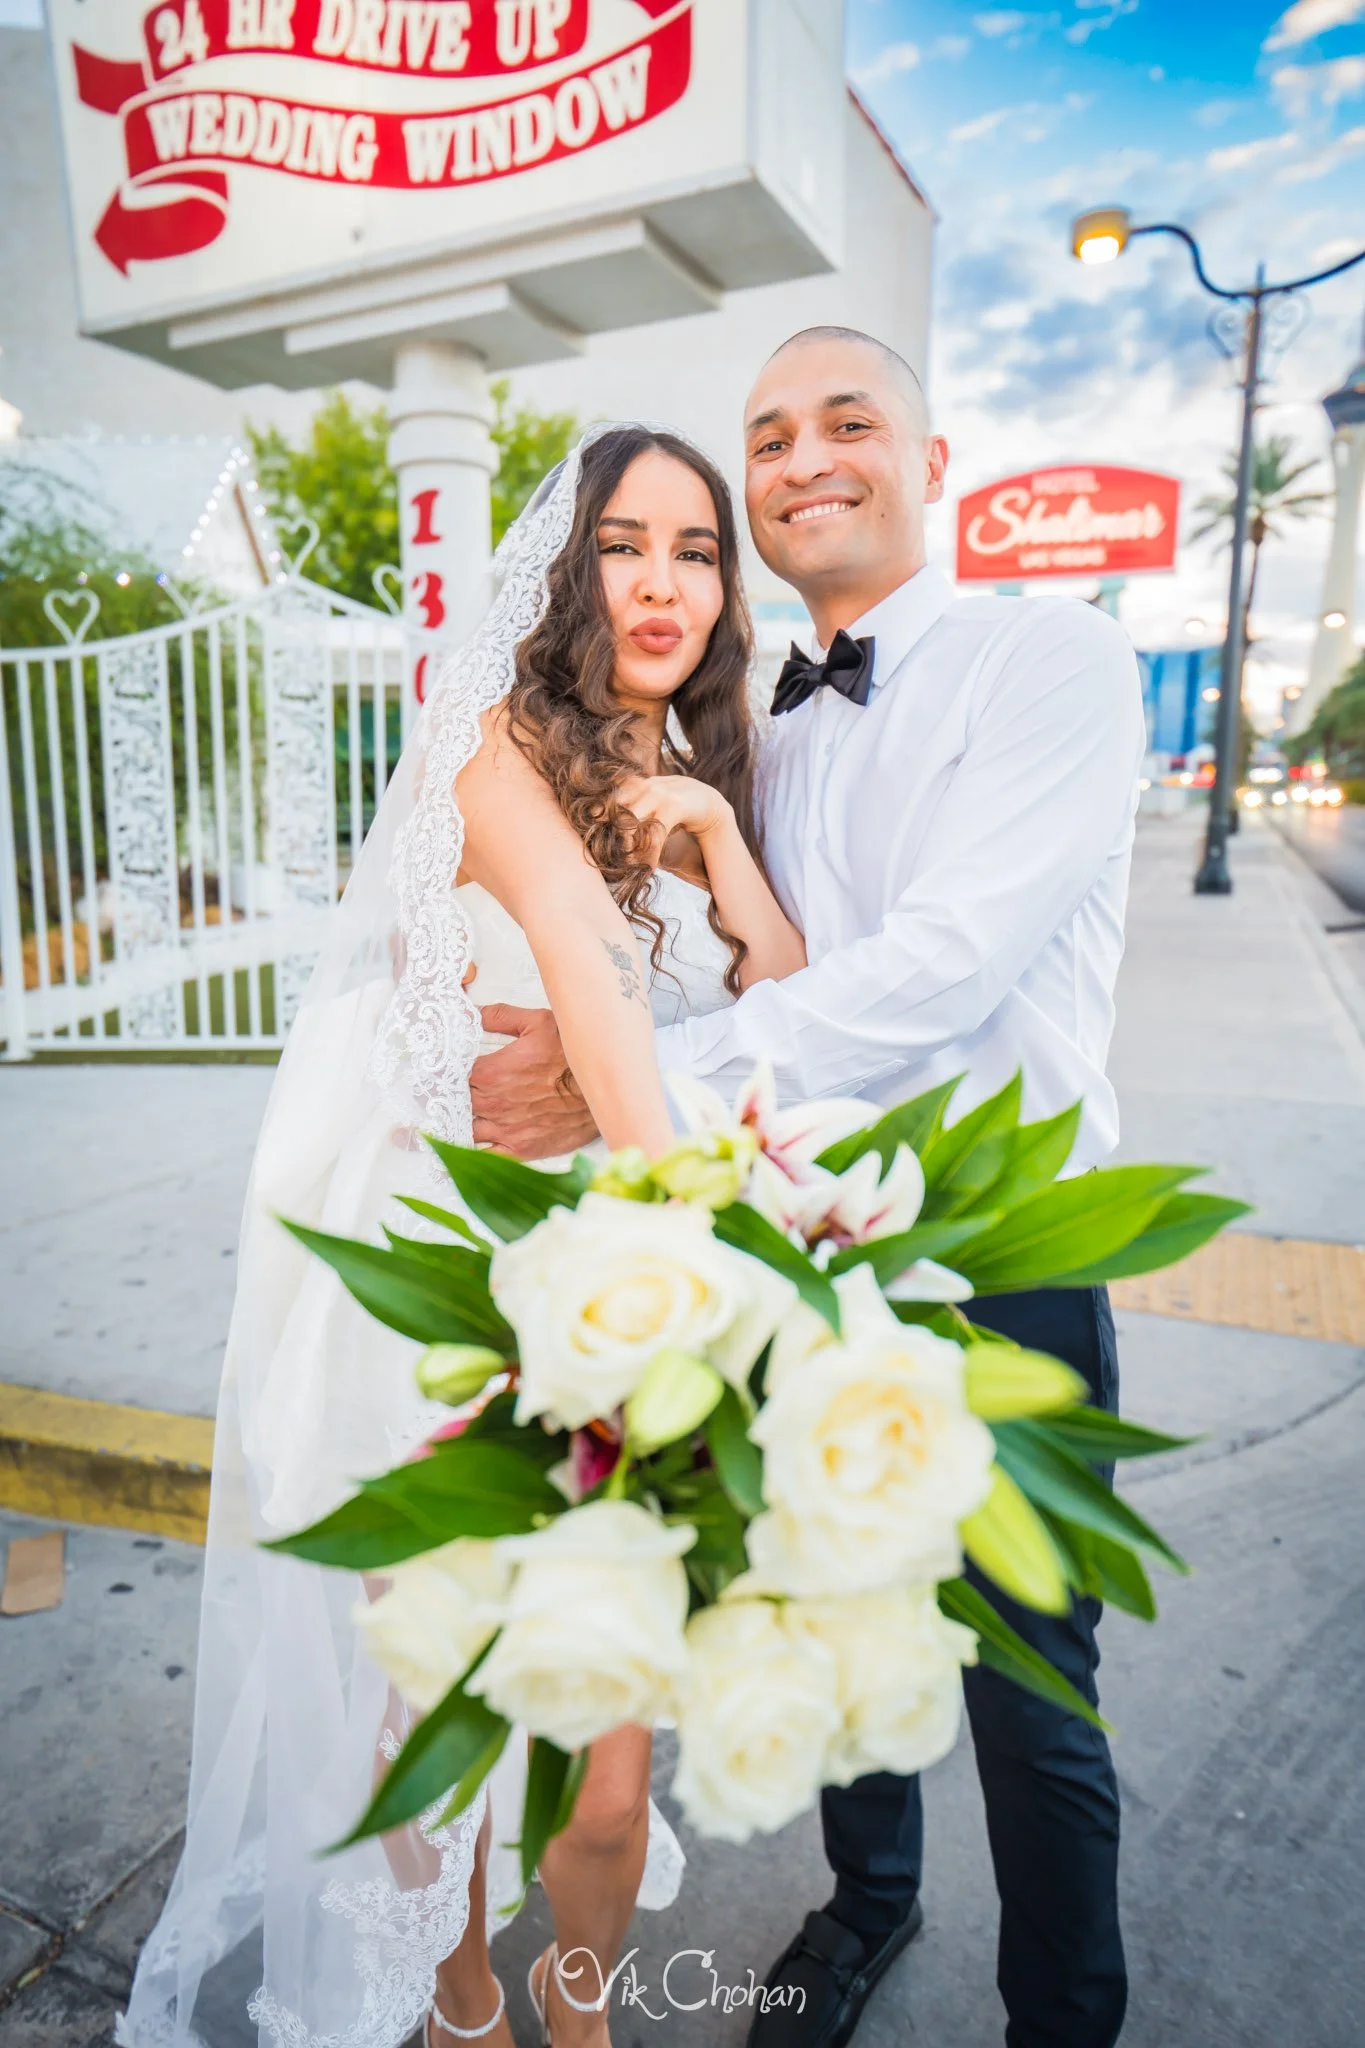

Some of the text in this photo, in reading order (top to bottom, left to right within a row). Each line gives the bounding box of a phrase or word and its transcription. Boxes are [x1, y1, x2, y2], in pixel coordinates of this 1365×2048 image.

[154, 0, 572, 71] 24 HR DRIVE UP
[146, 43, 652, 183] WEDDING WINDOW
